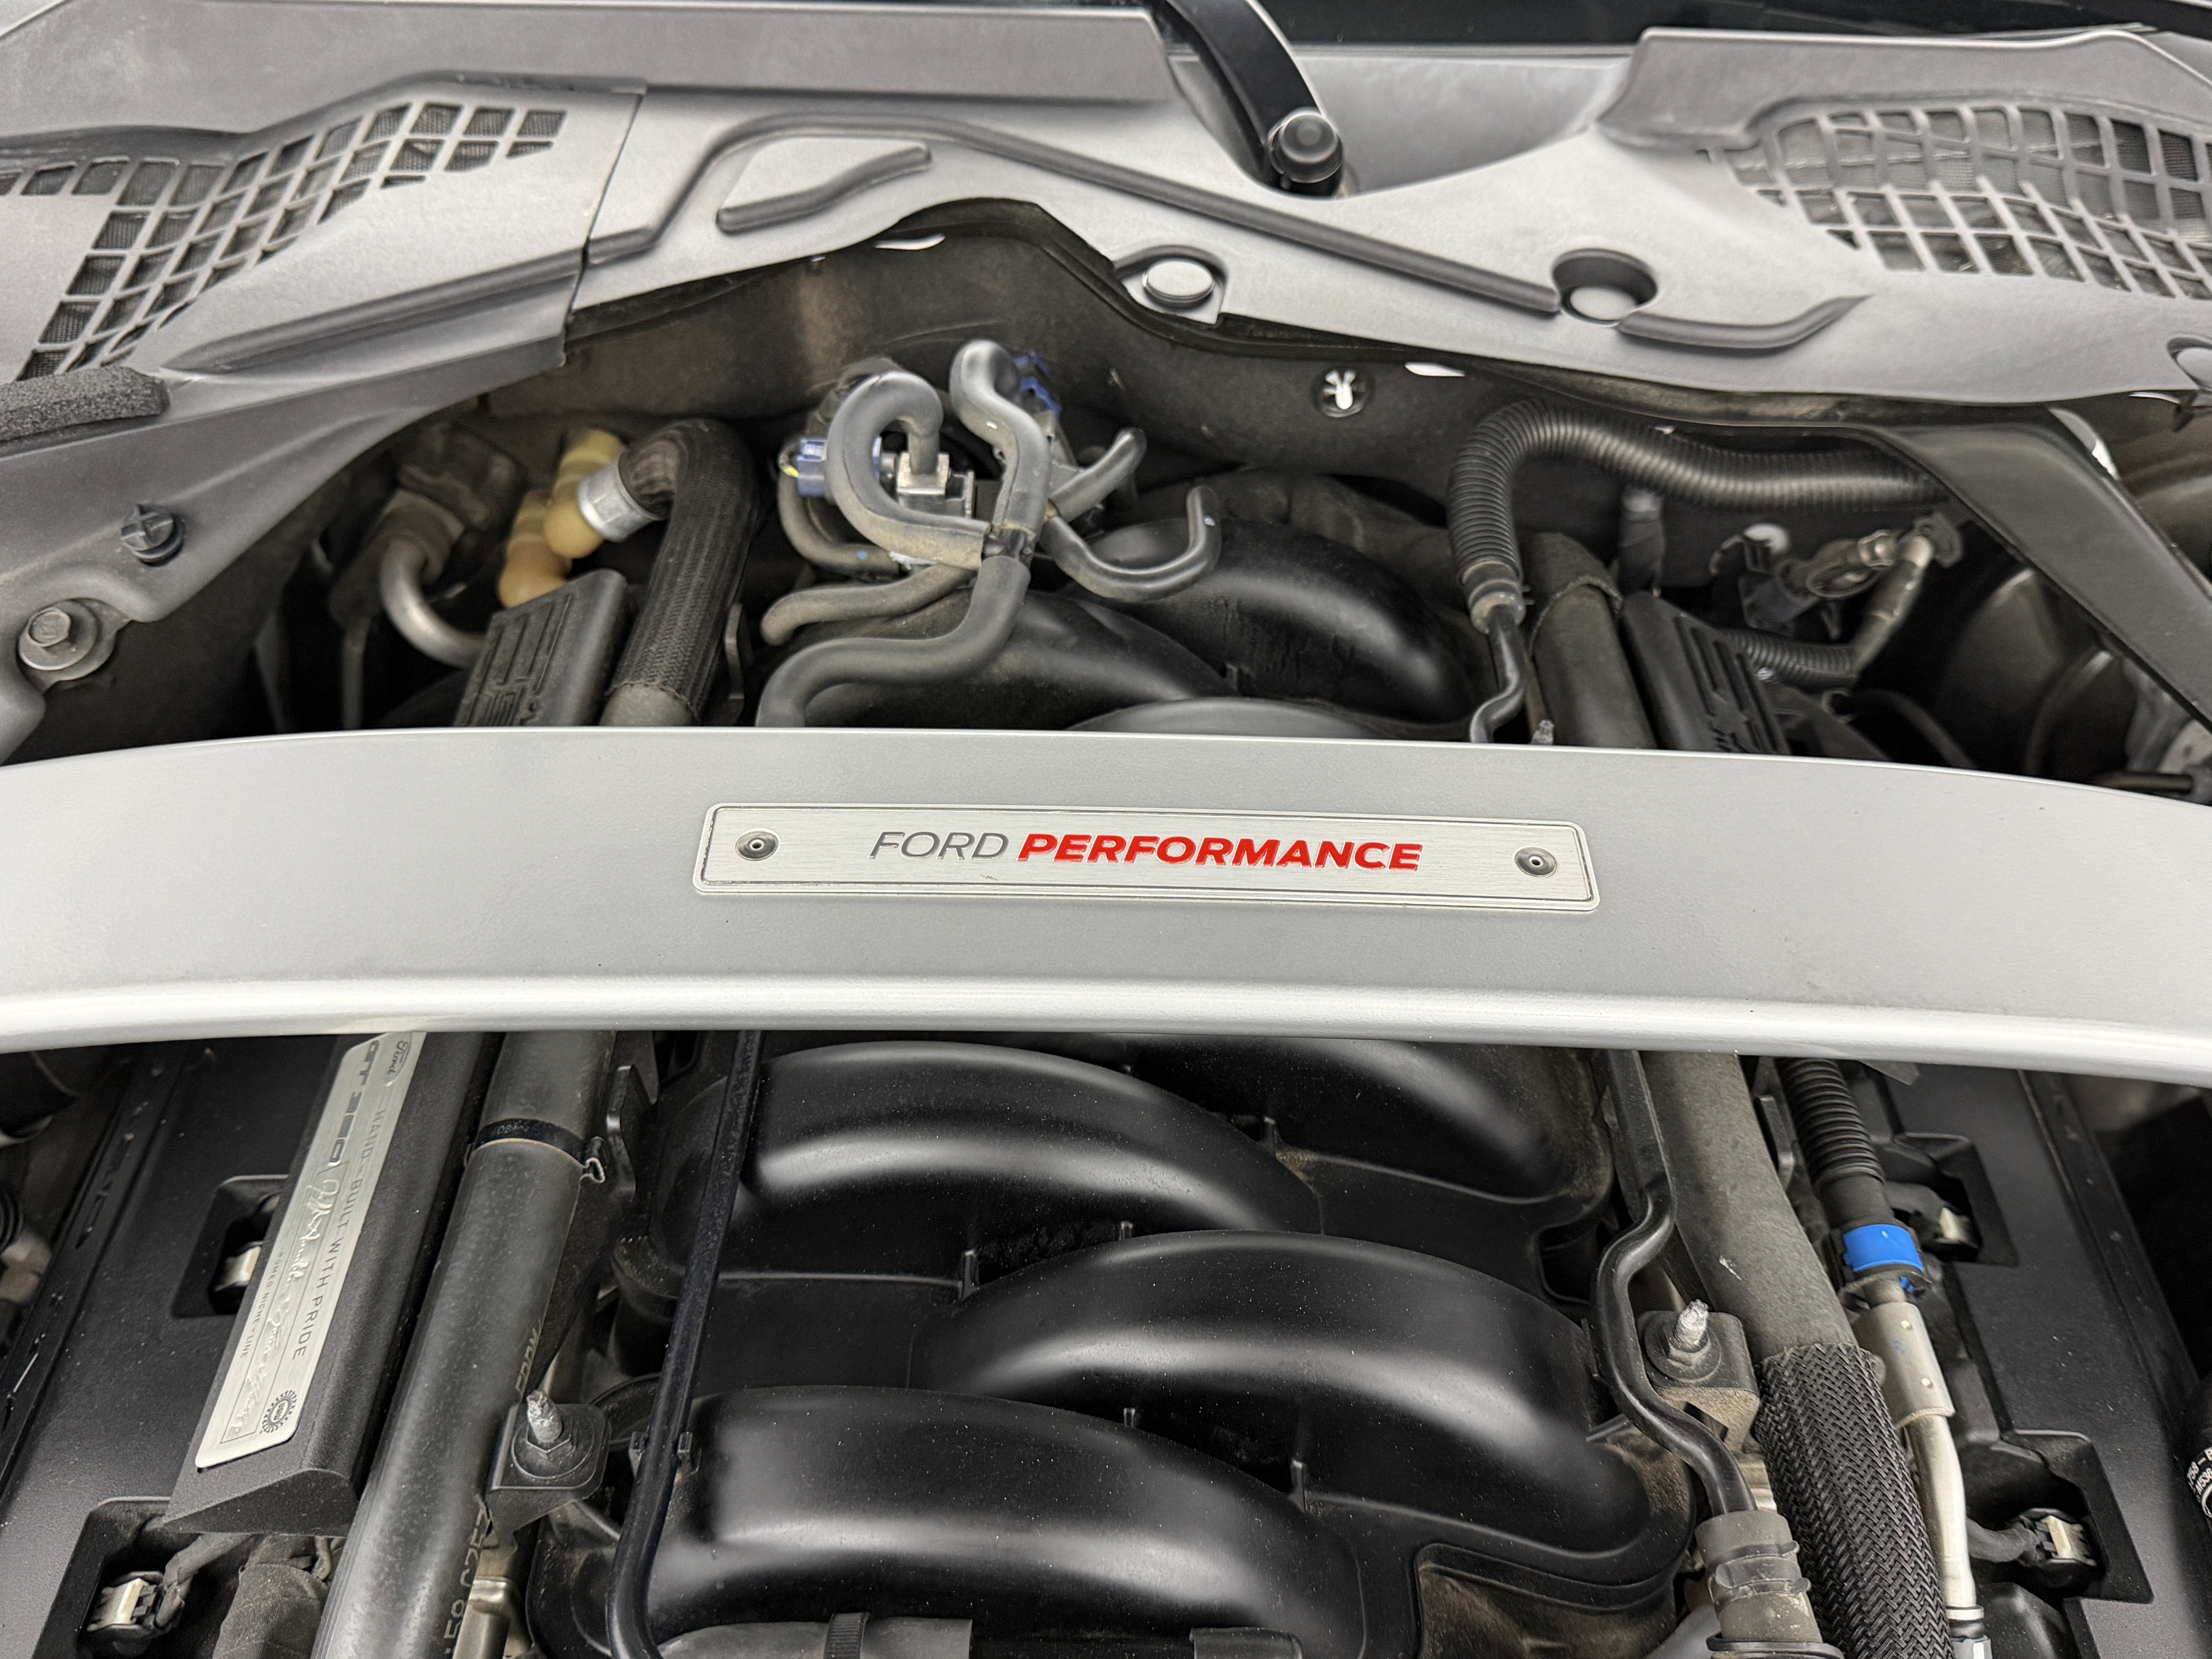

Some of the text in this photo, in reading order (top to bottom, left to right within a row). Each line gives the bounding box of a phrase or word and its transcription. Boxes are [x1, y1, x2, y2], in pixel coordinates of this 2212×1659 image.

[868, 831, 1423, 871] FORD PERFORMANCE
[388, 1039, 408, 1073] Ford
[316, 1237, 343, 1288] WITH
[292, 1295, 324, 1360] PRIDE
